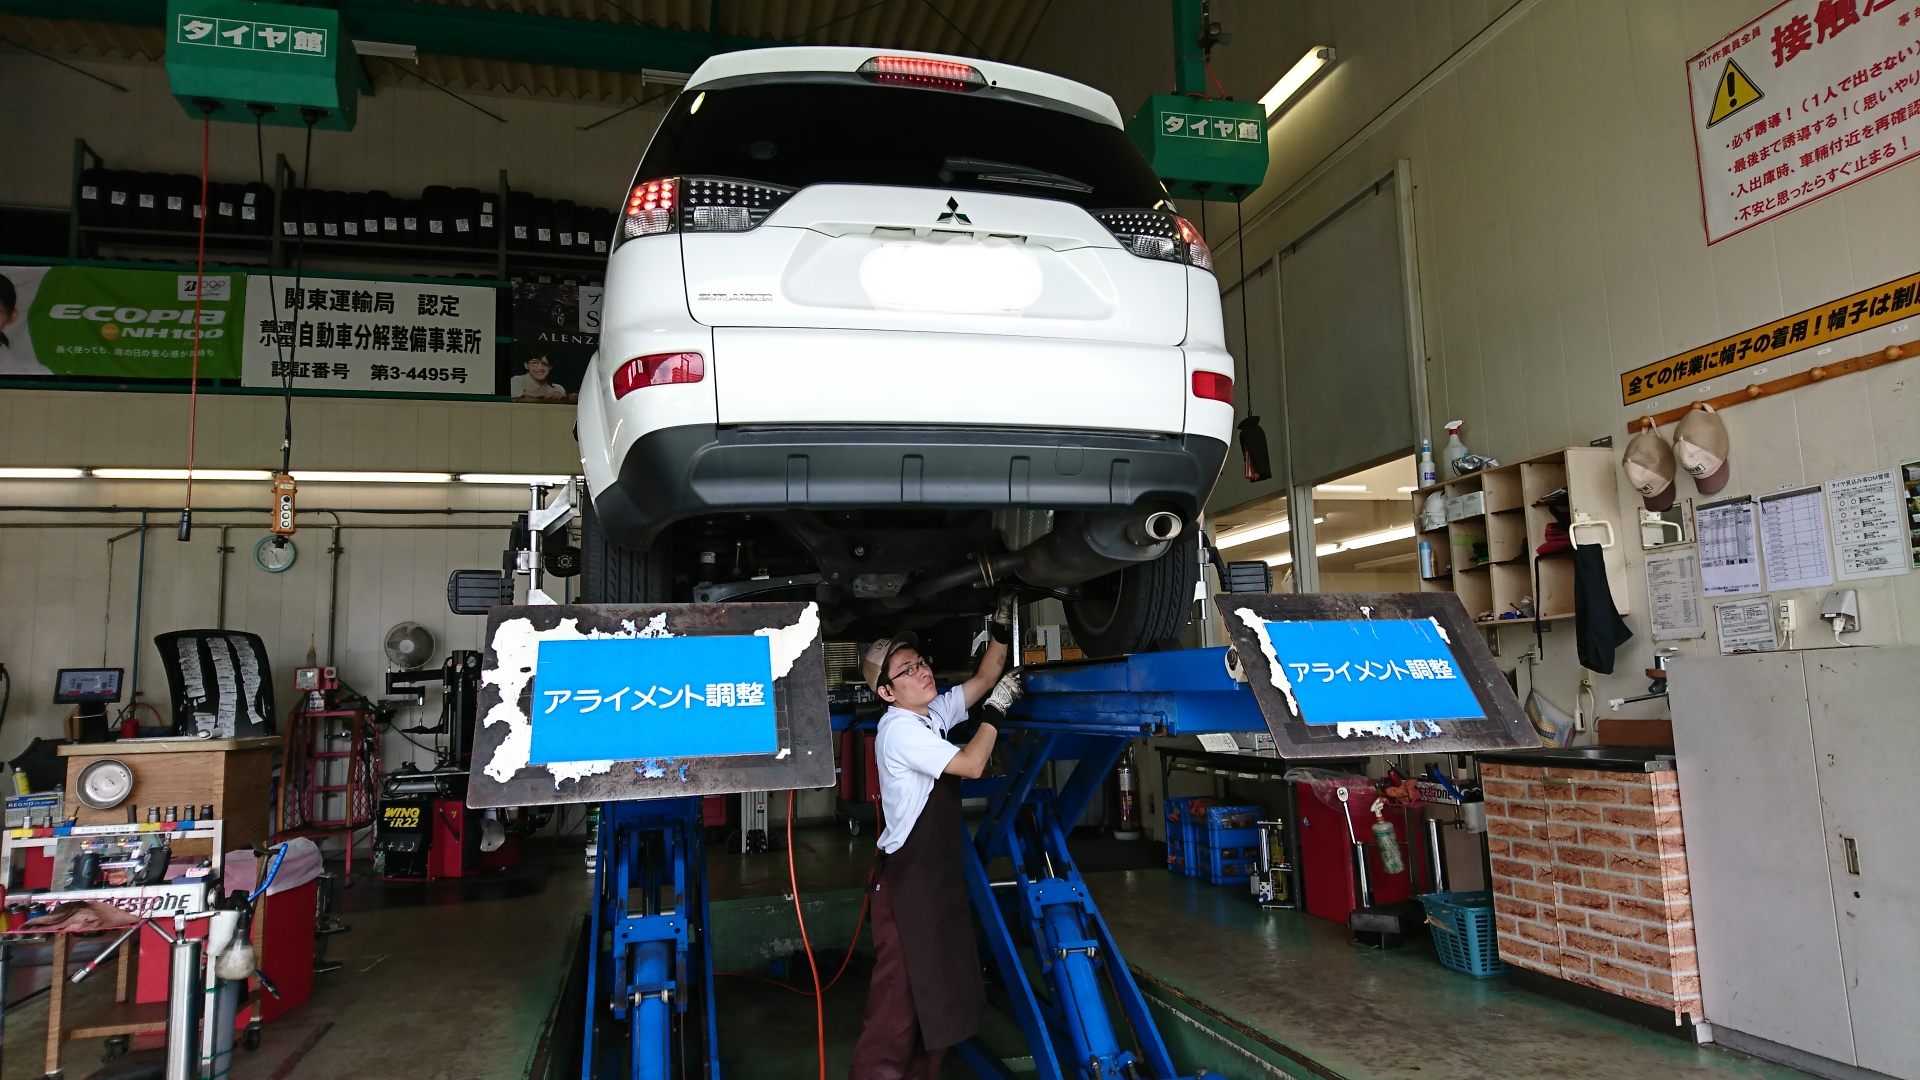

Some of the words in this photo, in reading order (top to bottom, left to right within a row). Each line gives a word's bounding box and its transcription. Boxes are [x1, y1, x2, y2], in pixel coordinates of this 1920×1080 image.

[183, 20, 323, 52] タイヤ館
[1771, 0, 1898, 68] 接触
[1698, 26, 1761, 70] PIT作業員全員
[1164, 116, 1258, 140] タイヤ館
[285, 288, 395, 315] 関東運輸局
[417, 294, 460, 317] 認定
[121, 327, 224, 340] NH100
[260, 319, 296, 334] 普通
[299, 321, 482, 355] 自動車分解整備事業所
[538, 332, 600, 345] ALENZ
[271, 361, 350, 380] 認証番号
[370, 364, 468, 384] 第3-4495号
[1288, 658, 1457, 682] アライメント調整
[543, 681, 766, 714] アライメント調整
[383, 807, 421, 818] WING
